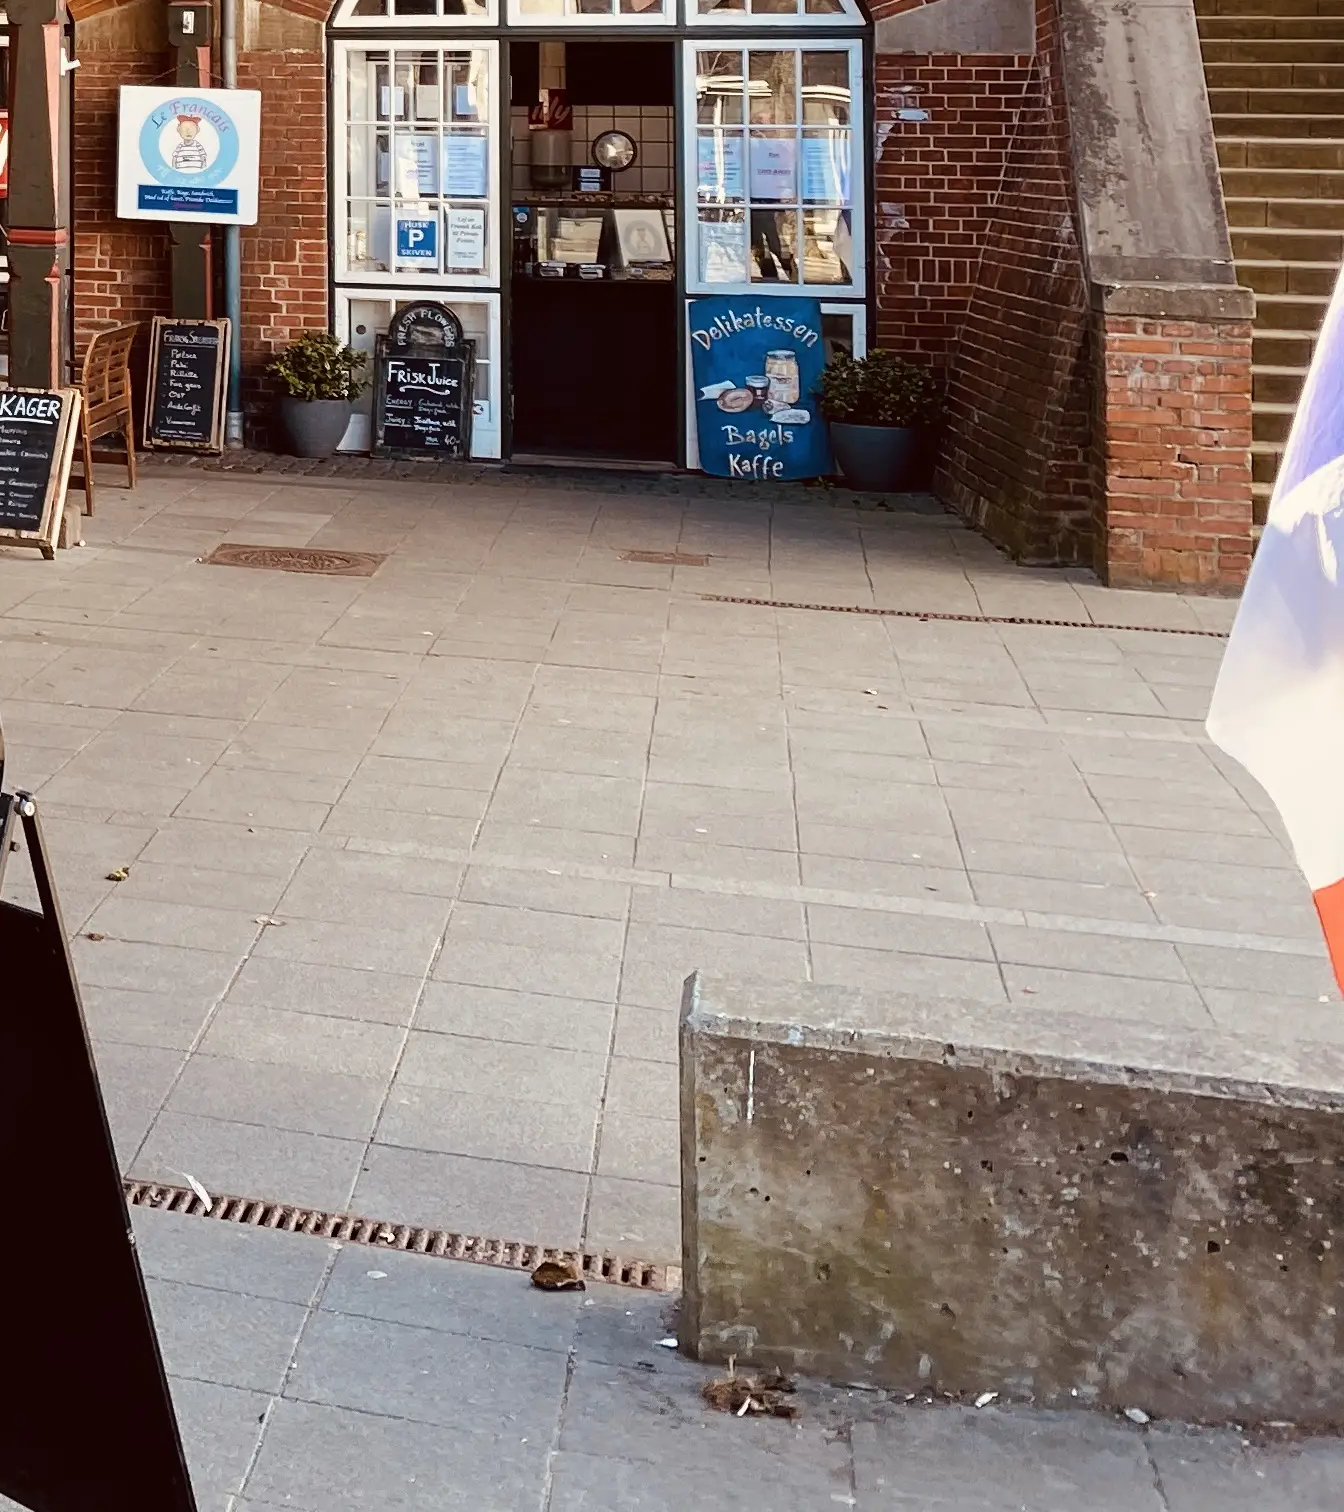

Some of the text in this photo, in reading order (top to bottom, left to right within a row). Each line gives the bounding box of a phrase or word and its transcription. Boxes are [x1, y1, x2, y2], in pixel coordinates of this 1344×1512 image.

[408, 229, 424, 248] P
[401, 248, 433, 257] SKIVEN
[397, 308, 455, 348] FRESH FLOWERS
[692, 306, 819, 351] Delikatessen
[0, 393, 61, 420] KAGER
[721, 424, 794, 451] Bagels
[728, 453, 784, 480] Kaffe
